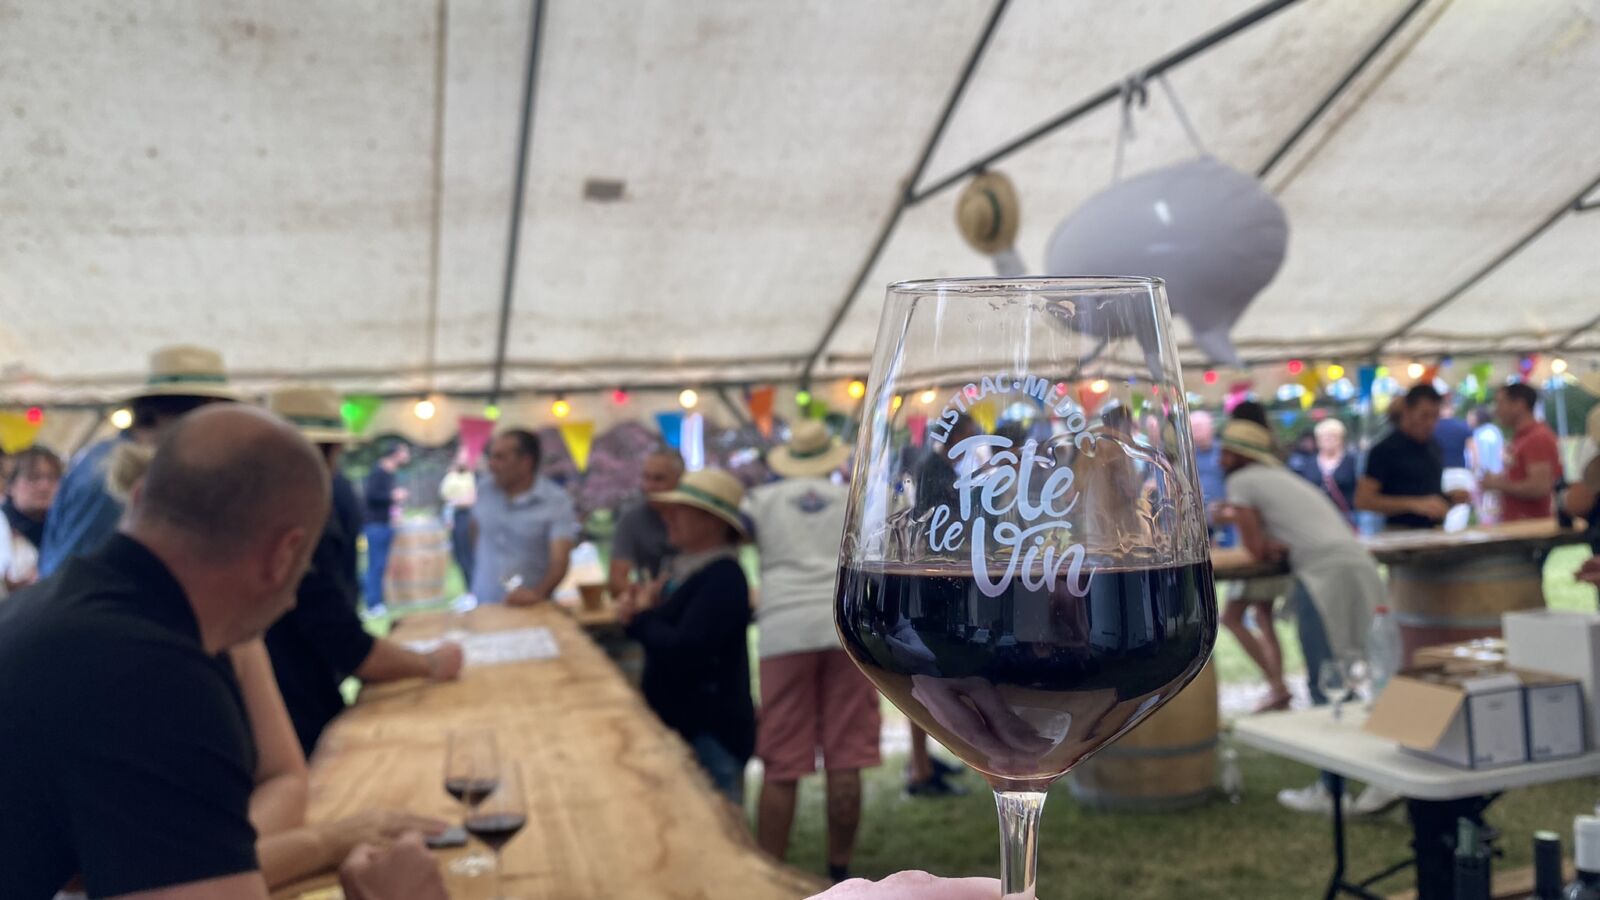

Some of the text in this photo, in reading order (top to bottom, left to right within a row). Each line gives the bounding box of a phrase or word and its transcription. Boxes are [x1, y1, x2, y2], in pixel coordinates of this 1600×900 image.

[947, 434, 1080, 521] Fête
[926, 504, 1097, 598] le Vin
